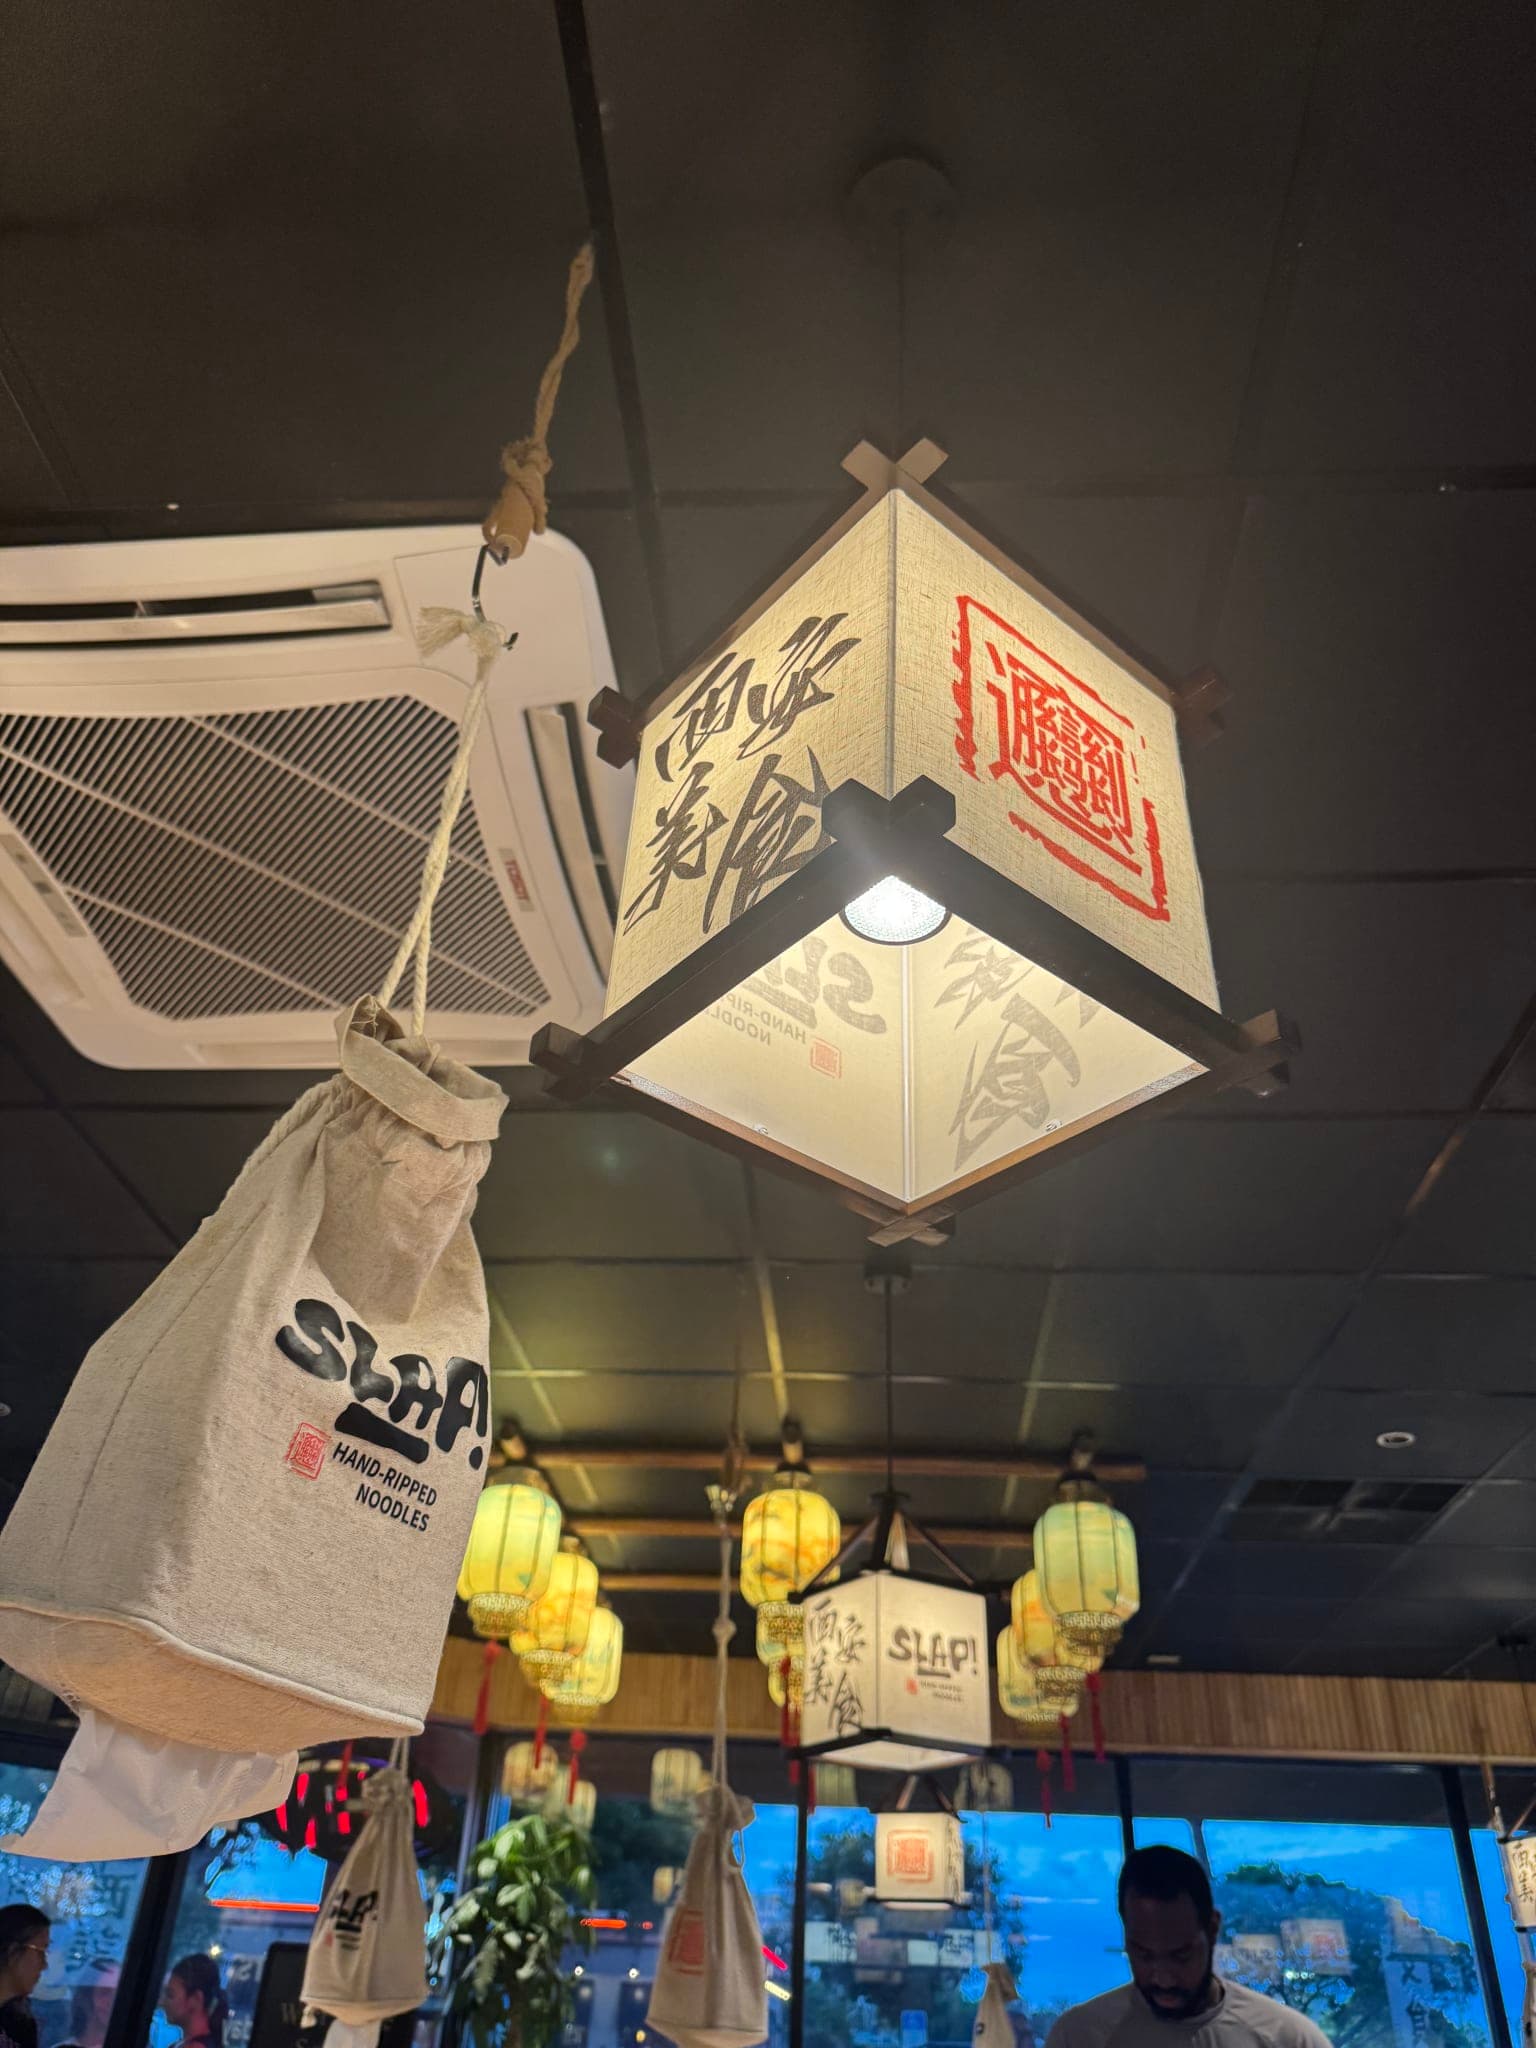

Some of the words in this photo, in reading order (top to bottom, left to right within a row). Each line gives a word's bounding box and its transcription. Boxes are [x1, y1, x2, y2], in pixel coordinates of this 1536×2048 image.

[274, 1298, 489, 1471] SLAP!
[332, 1441, 438, 1507] HAND-RIPPED
[355, 1482, 431, 1533] NOODLES
[888, 1624, 979, 1676] SLAP!
